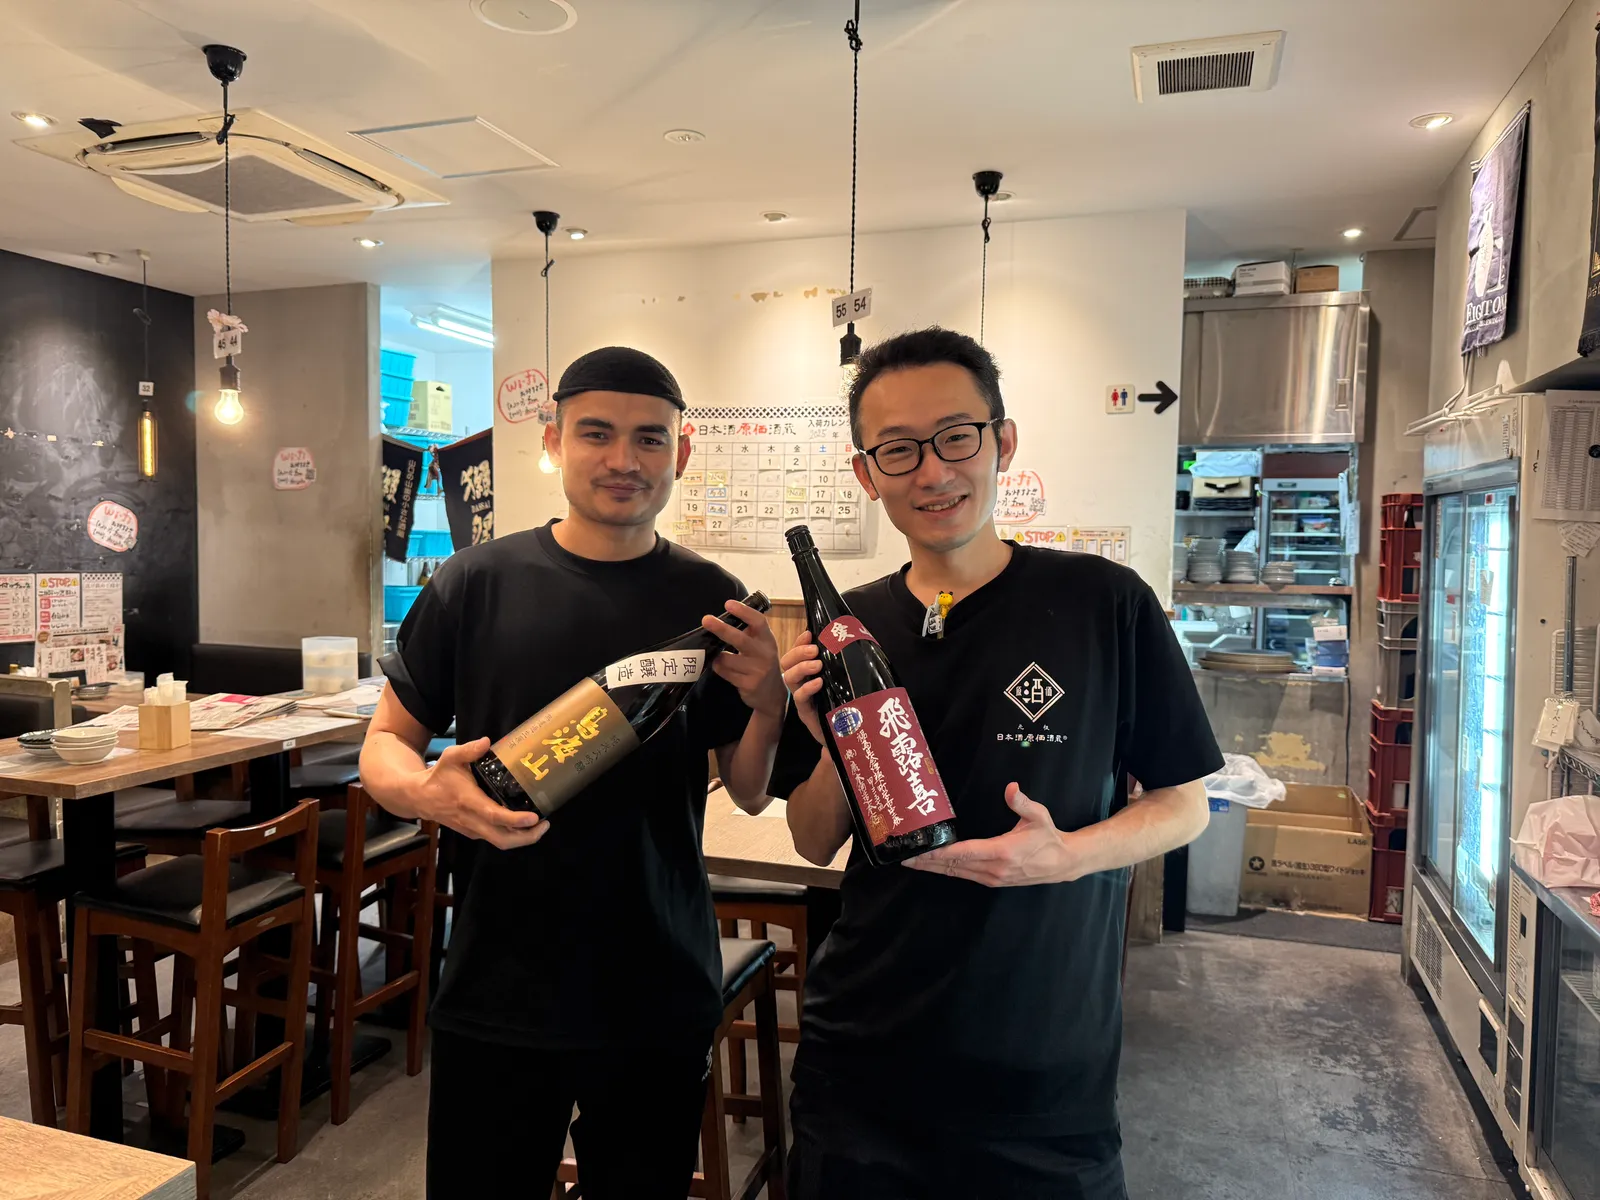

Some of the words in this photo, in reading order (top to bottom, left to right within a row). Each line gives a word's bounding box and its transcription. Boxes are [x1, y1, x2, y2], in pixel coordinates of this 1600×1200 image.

[836, 303, 847, 318] 55
[854, 296, 866, 312] 54
[218, 338, 226, 350] 45
[230, 334, 238, 346] 44
[715, 445, 723, 453] 火
[741, 445, 749, 453] 水
[767, 445, 775, 453] 木
[794, 445, 801, 453] 金
[819, 445, 827, 453] 土
[845, 444, 852, 452] 日
[793, 457, 799, 466] 2
[821, 459, 827, 467] 3
[845, 457, 850, 465] 4
[687, 503, 698, 511] 19
[736, 505, 748, 513] 21
[764, 506, 774, 514] 22
[815, 506, 825, 514] 24
[838, 506, 851, 514] 25
[1549, 709, 1561, 737] イベント
[519, 705, 609, 781] 鳥海山
[876, 696, 939, 817] 飛露喜
